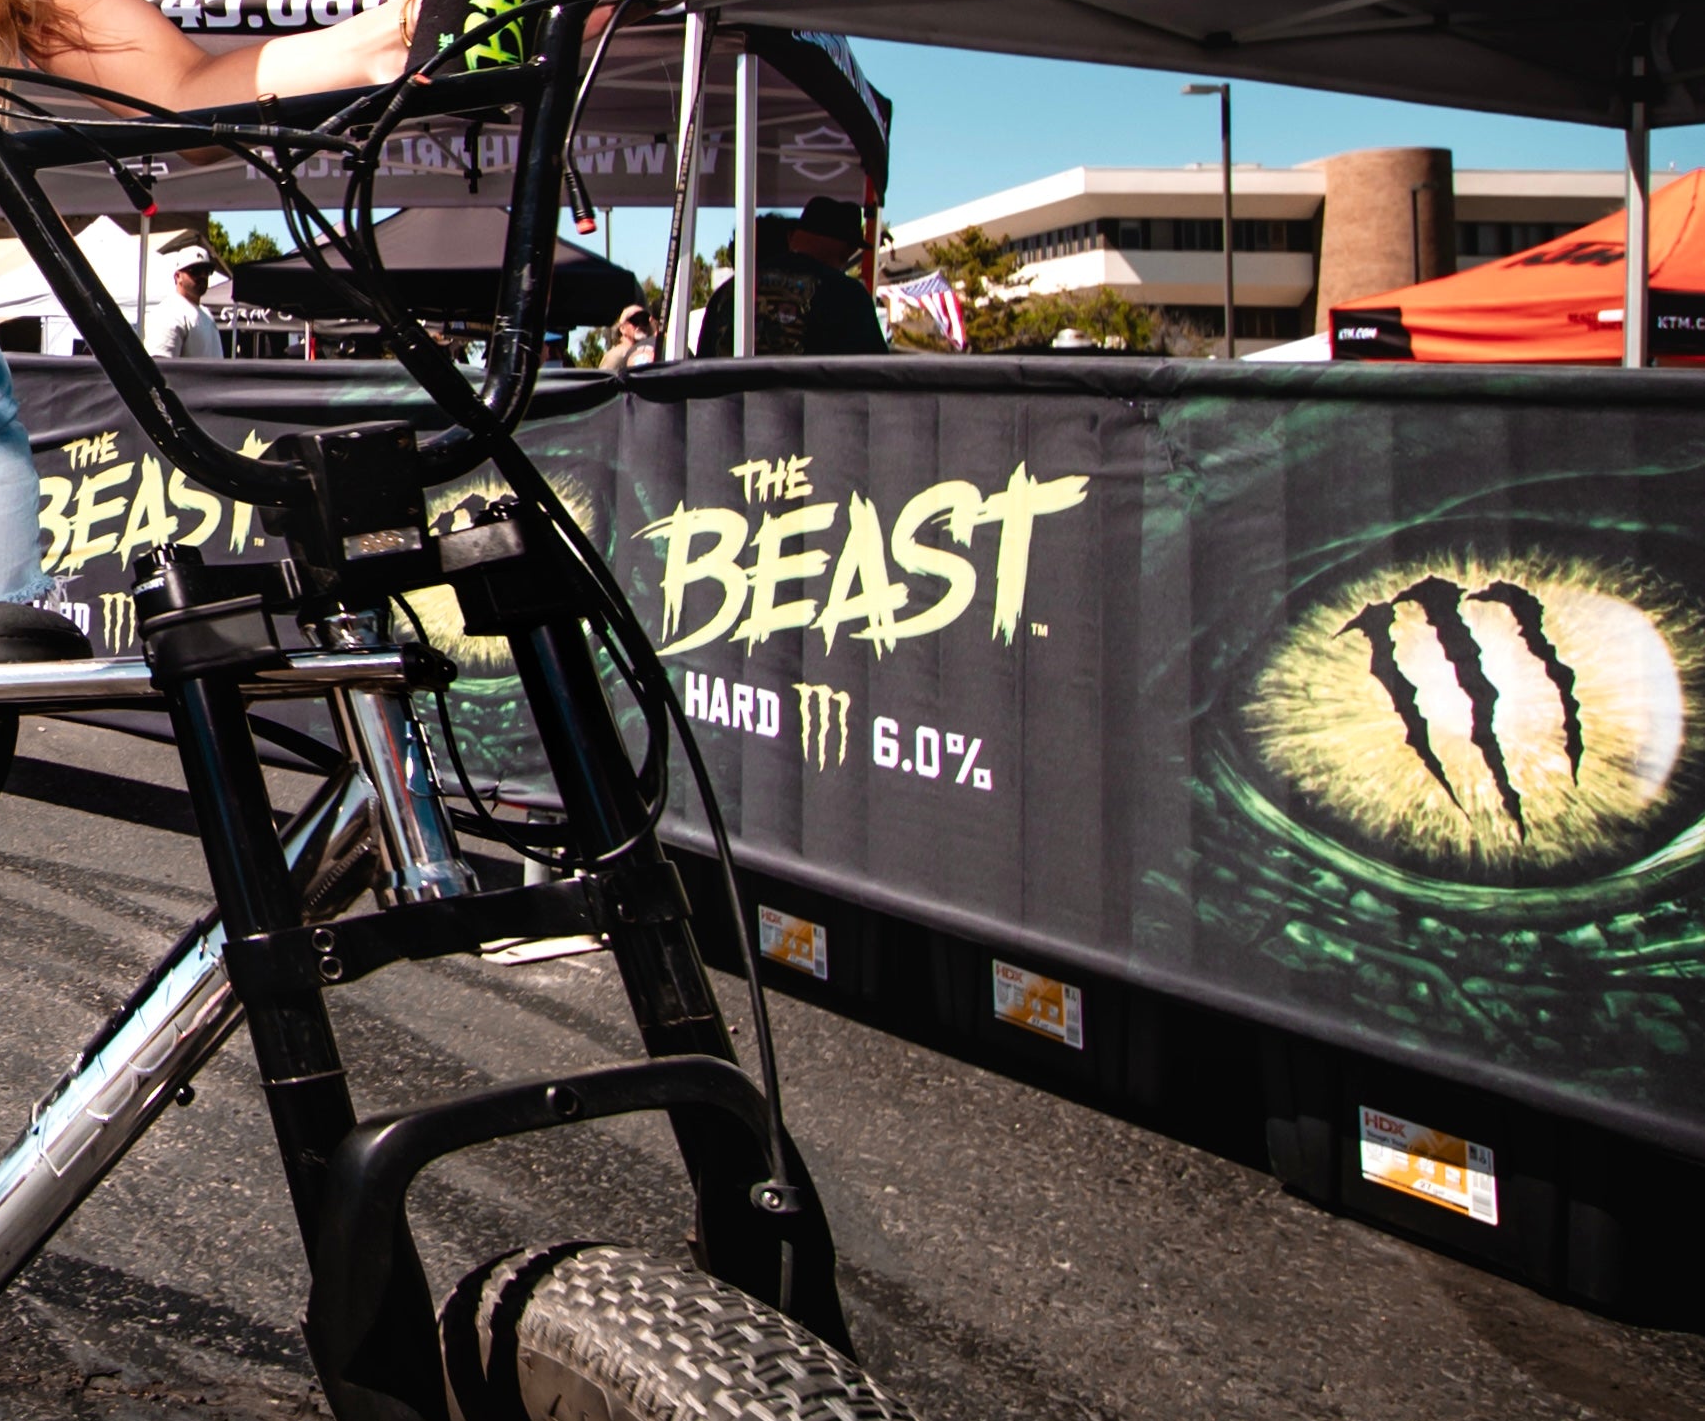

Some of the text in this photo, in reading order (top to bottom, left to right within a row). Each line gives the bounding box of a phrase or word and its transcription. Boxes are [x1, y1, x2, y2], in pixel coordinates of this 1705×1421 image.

[1657, 315, 1705, 330] KTM.C
[61, 431, 120, 471] THE
[38, 429, 273, 578] BEAST
[729, 454, 814, 505] THE
[631, 461, 1091, 661] BEAST
[685, 671, 992, 791] HARD 6.0%
[1364, 1110, 1408, 1139] HDX
